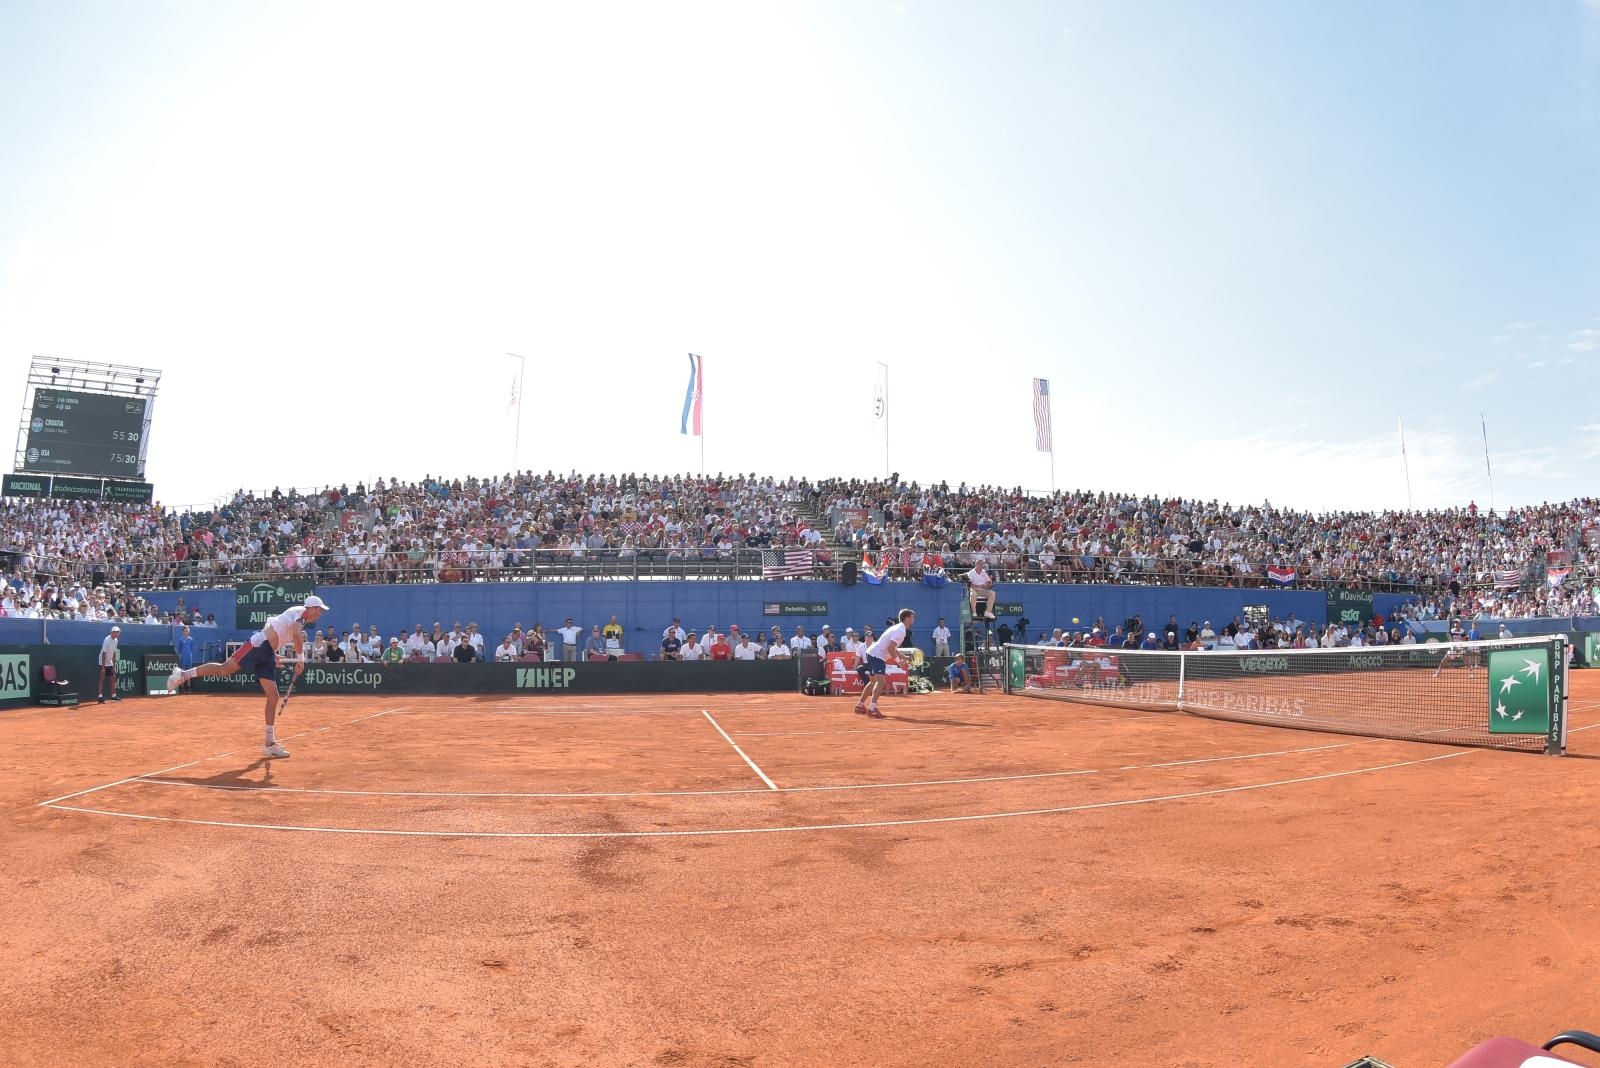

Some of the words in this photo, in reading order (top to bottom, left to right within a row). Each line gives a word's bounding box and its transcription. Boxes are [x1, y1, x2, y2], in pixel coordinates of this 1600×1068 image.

[127, 433, 139, 441] 30
[125, 455, 136, 464] 30
[11, 481, 42, 491] NACIONAL
[237, 594, 249, 604] an
[253, 590, 275, 603] ITF
[1340, 591, 1373, 603] #DavisCup
[147, 660, 179, 671] Adecco
[203, 673, 256, 686] DavisCup.c
[305, 668, 382, 689] #DavisCup
[536, 667, 576, 688] HEP
[1552, 675, 1560, 741] PARIBAS
